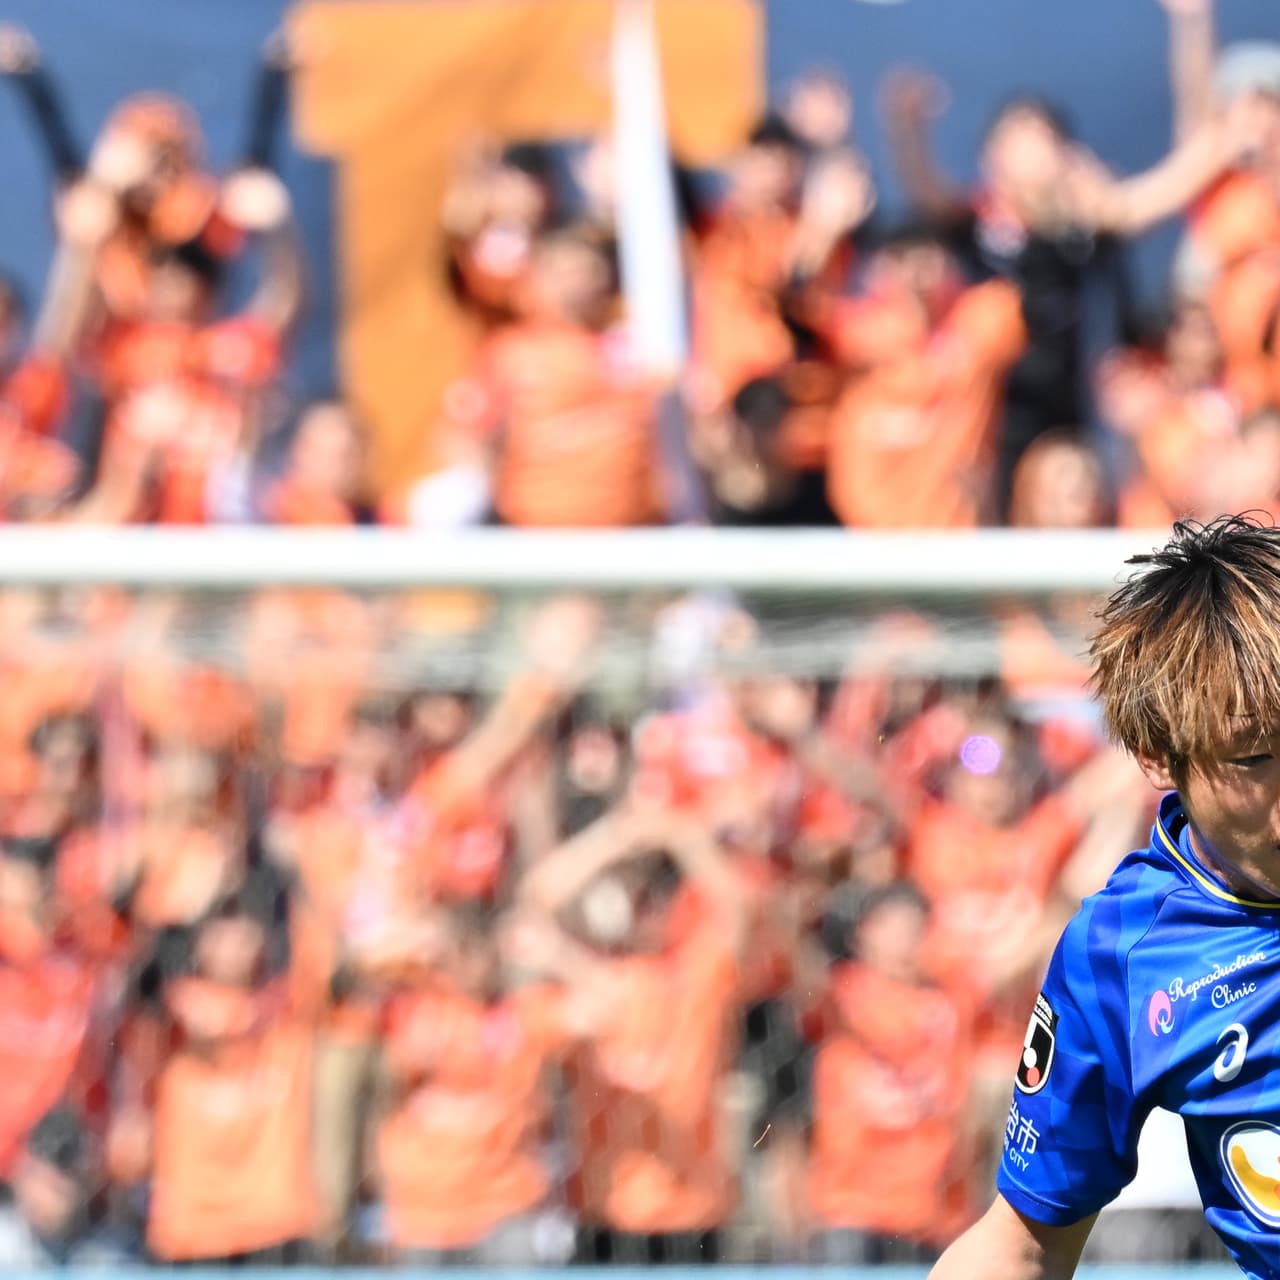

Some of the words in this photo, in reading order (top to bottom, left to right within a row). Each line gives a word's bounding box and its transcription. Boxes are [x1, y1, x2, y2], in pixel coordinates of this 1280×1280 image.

[1168, 951, 1267, 1002] Reproduction
[1211, 982, 1257, 1009] Clinic
[1009, 1147, 1029, 1172] CITY
